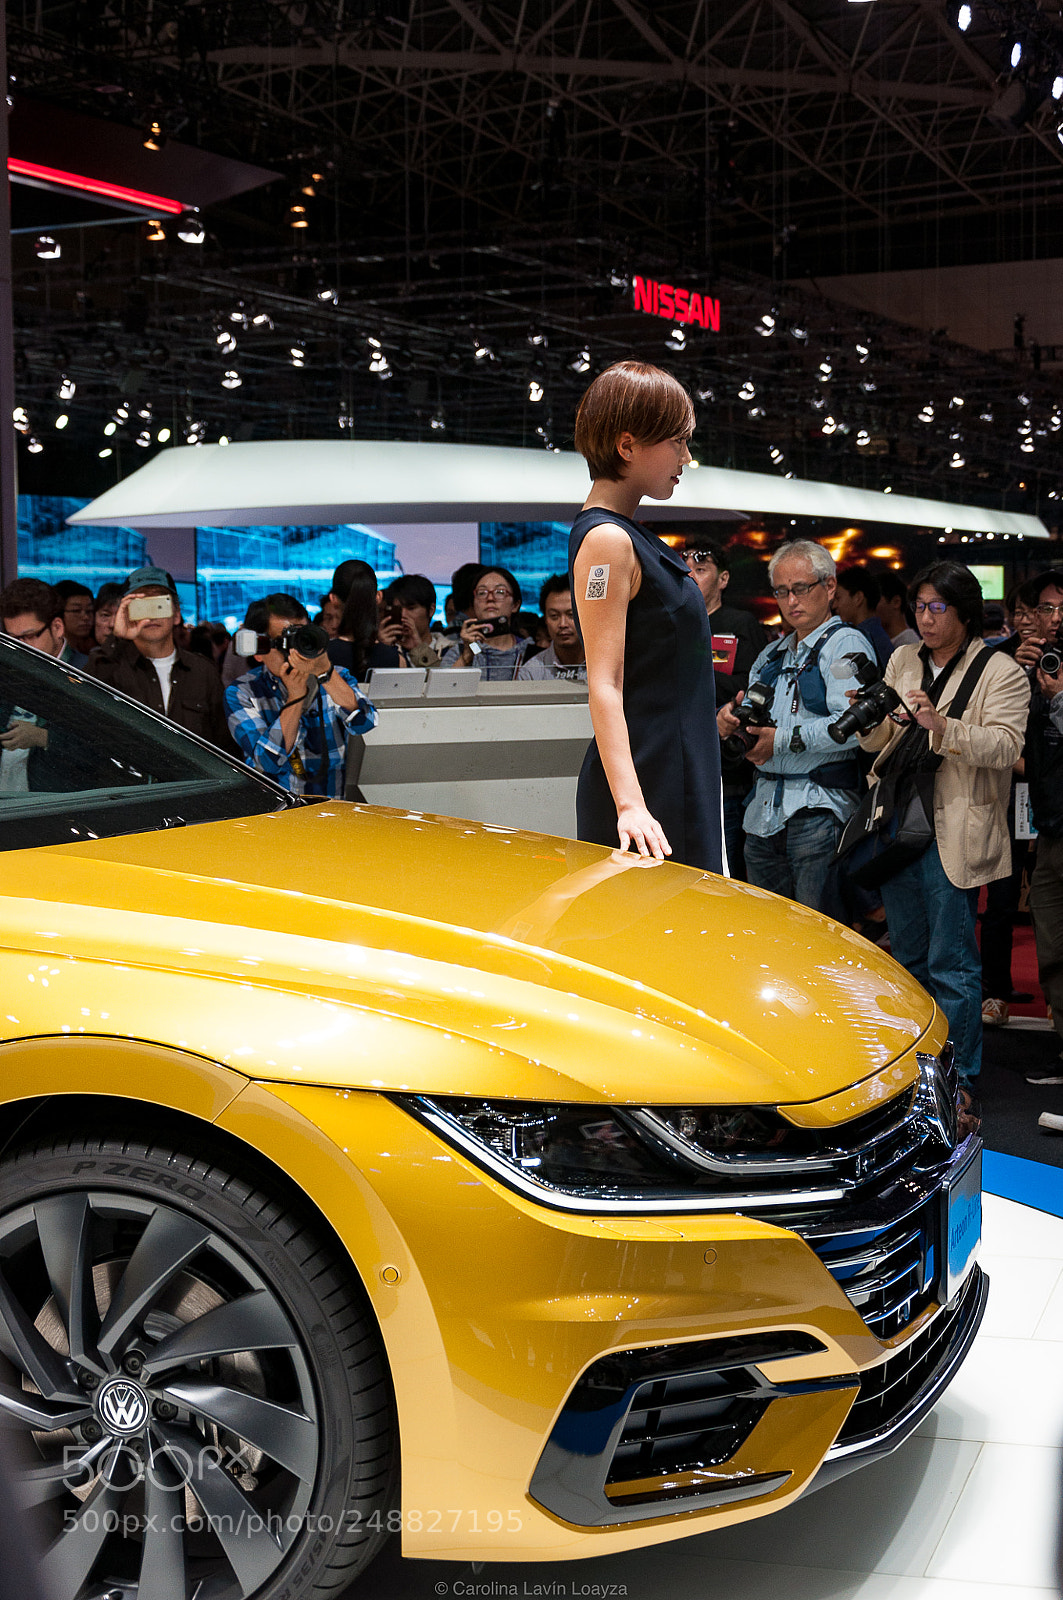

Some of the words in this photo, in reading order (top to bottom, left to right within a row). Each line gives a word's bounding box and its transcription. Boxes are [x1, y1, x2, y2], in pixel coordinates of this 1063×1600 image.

[634, 275, 720, 332] NISSAN
[72, 1160, 97, 1175] P
[103, 1162, 206, 1201] ZERO
[950, 1215, 968, 1253] Arteon
